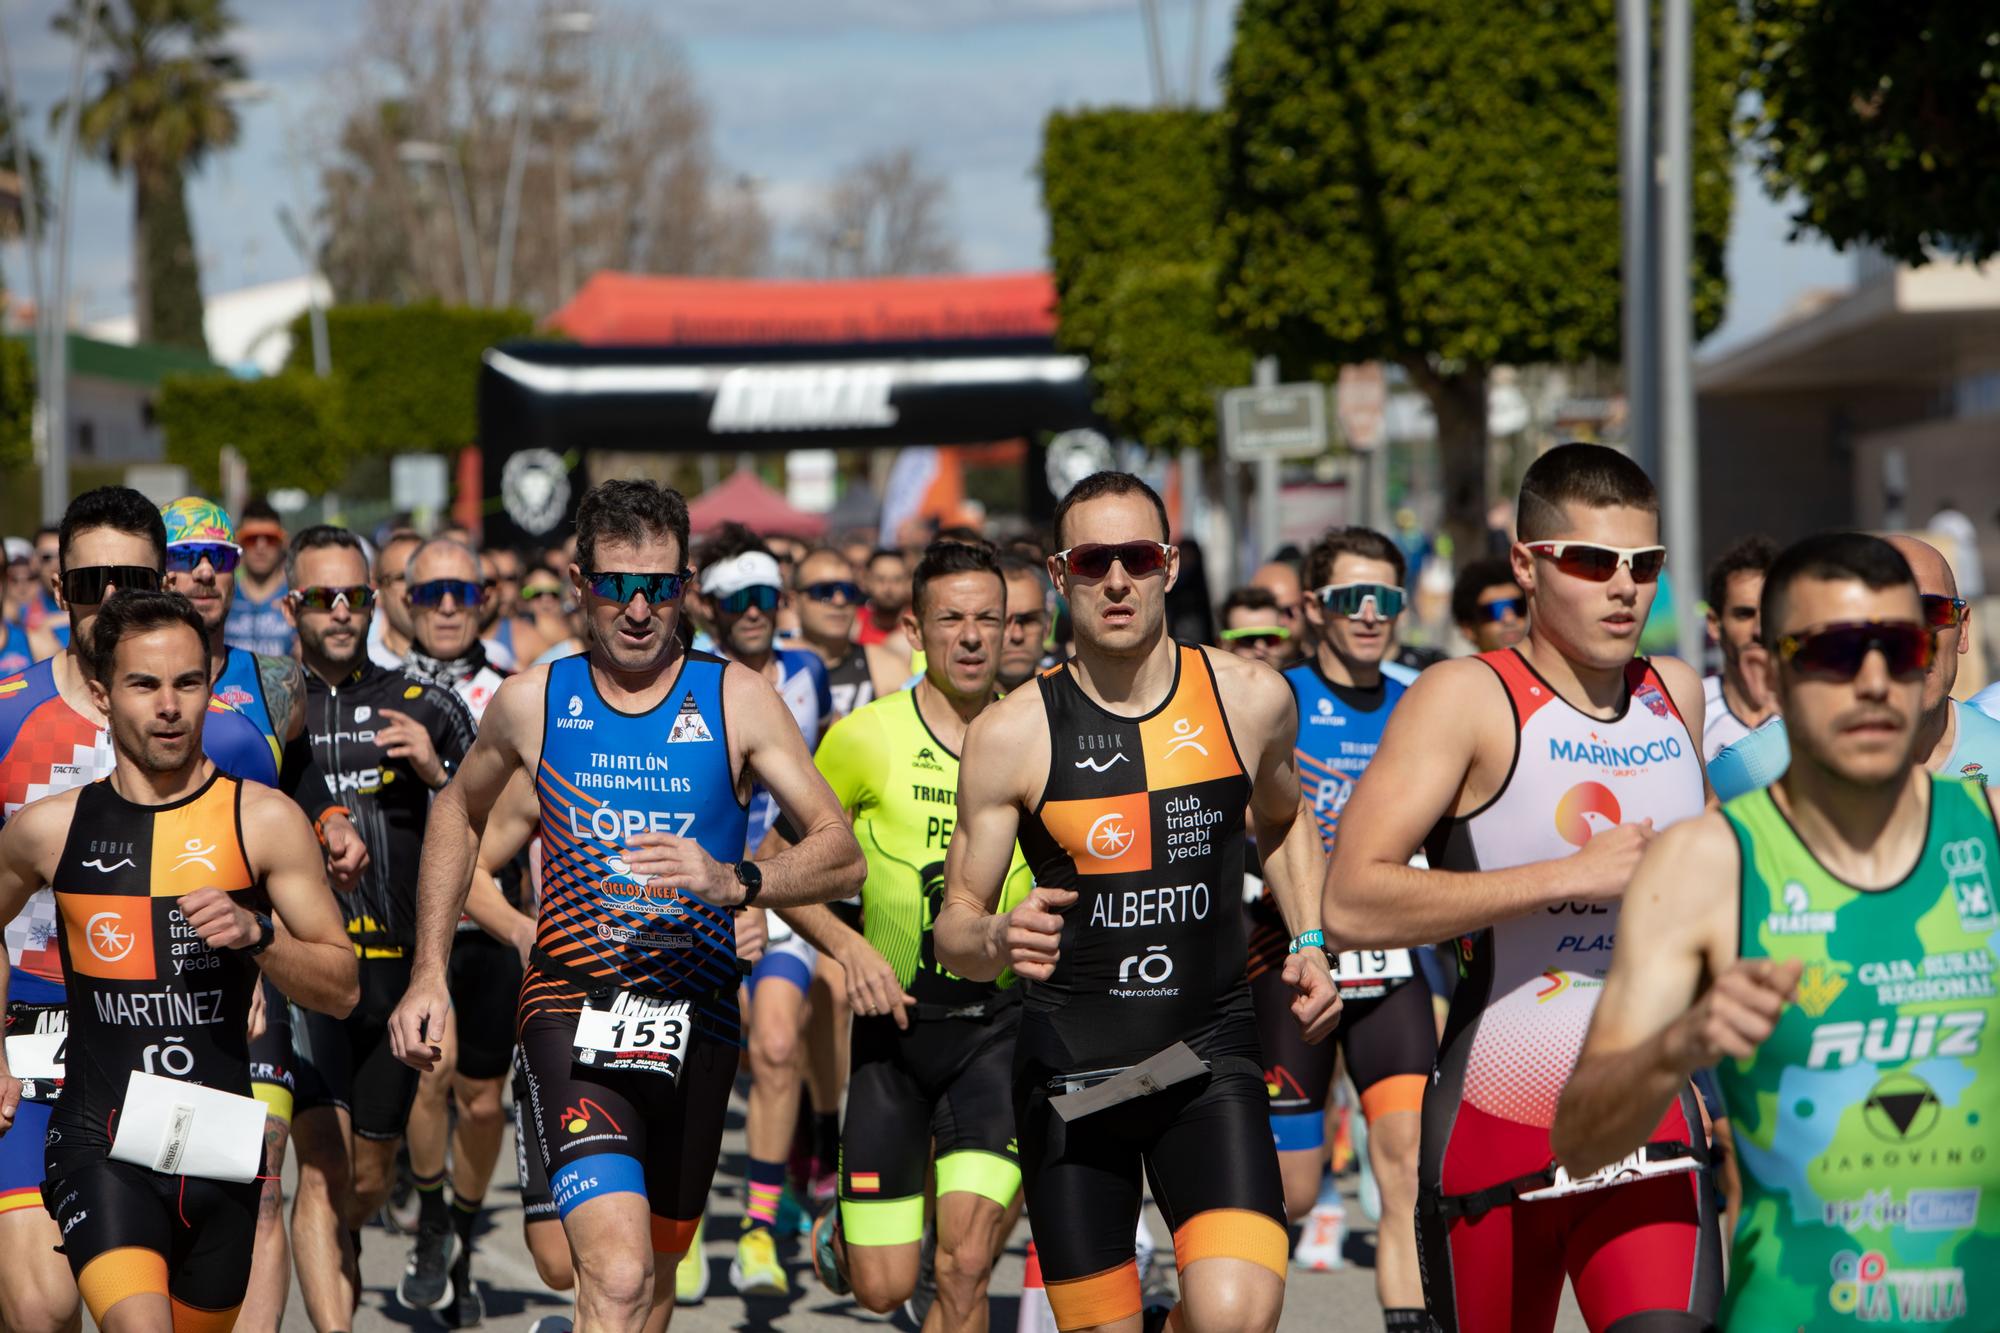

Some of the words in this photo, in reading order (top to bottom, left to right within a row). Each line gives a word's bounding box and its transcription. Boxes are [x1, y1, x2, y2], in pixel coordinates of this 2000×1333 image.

[556, 717, 594, 730] VIATOR
[1078, 733, 1124, 749] GOBIK
[1549, 736, 1682, 767] MARINOCIO
[53, 765, 81, 775] TACTIC
[590, 752, 669, 771] TRIATLÓN
[574, 772, 692, 793] TRAGAMILLAS
[1165, 794, 1201, 814] club
[569, 800, 697, 842] LÓPEZ
[1166, 808, 1223, 830] triatlón
[926, 815, 953, 850] PE
[1167, 827, 1211, 845] arabí
[90, 839, 135, 855] GOBIK
[1167, 841, 1212, 864] yecla
[602, 881, 640, 897] CICLOS
[645, 884, 678, 899] VICEA
[601, 901, 684, 915] www.ciclosvicea.com
[1090, 882, 1210, 928] ALBERTO
[172, 953, 221, 975] yecla
[1857, 958, 1917, 985] CAJA
[1923, 949, 1995, 978] RURAL
[1109, 985, 1180, 998] reyesordoñez
[1877, 974, 1997, 1006] REGIONAL
[93, 983, 225, 1027] MARTÍNEZ
[609, 990, 692, 1018] ANIMAL
[612, 1019, 683, 1051] 153
[1806, 1010, 1986, 1070] RUIZ
[1894, 1268, 1966, 1322] VILLA
